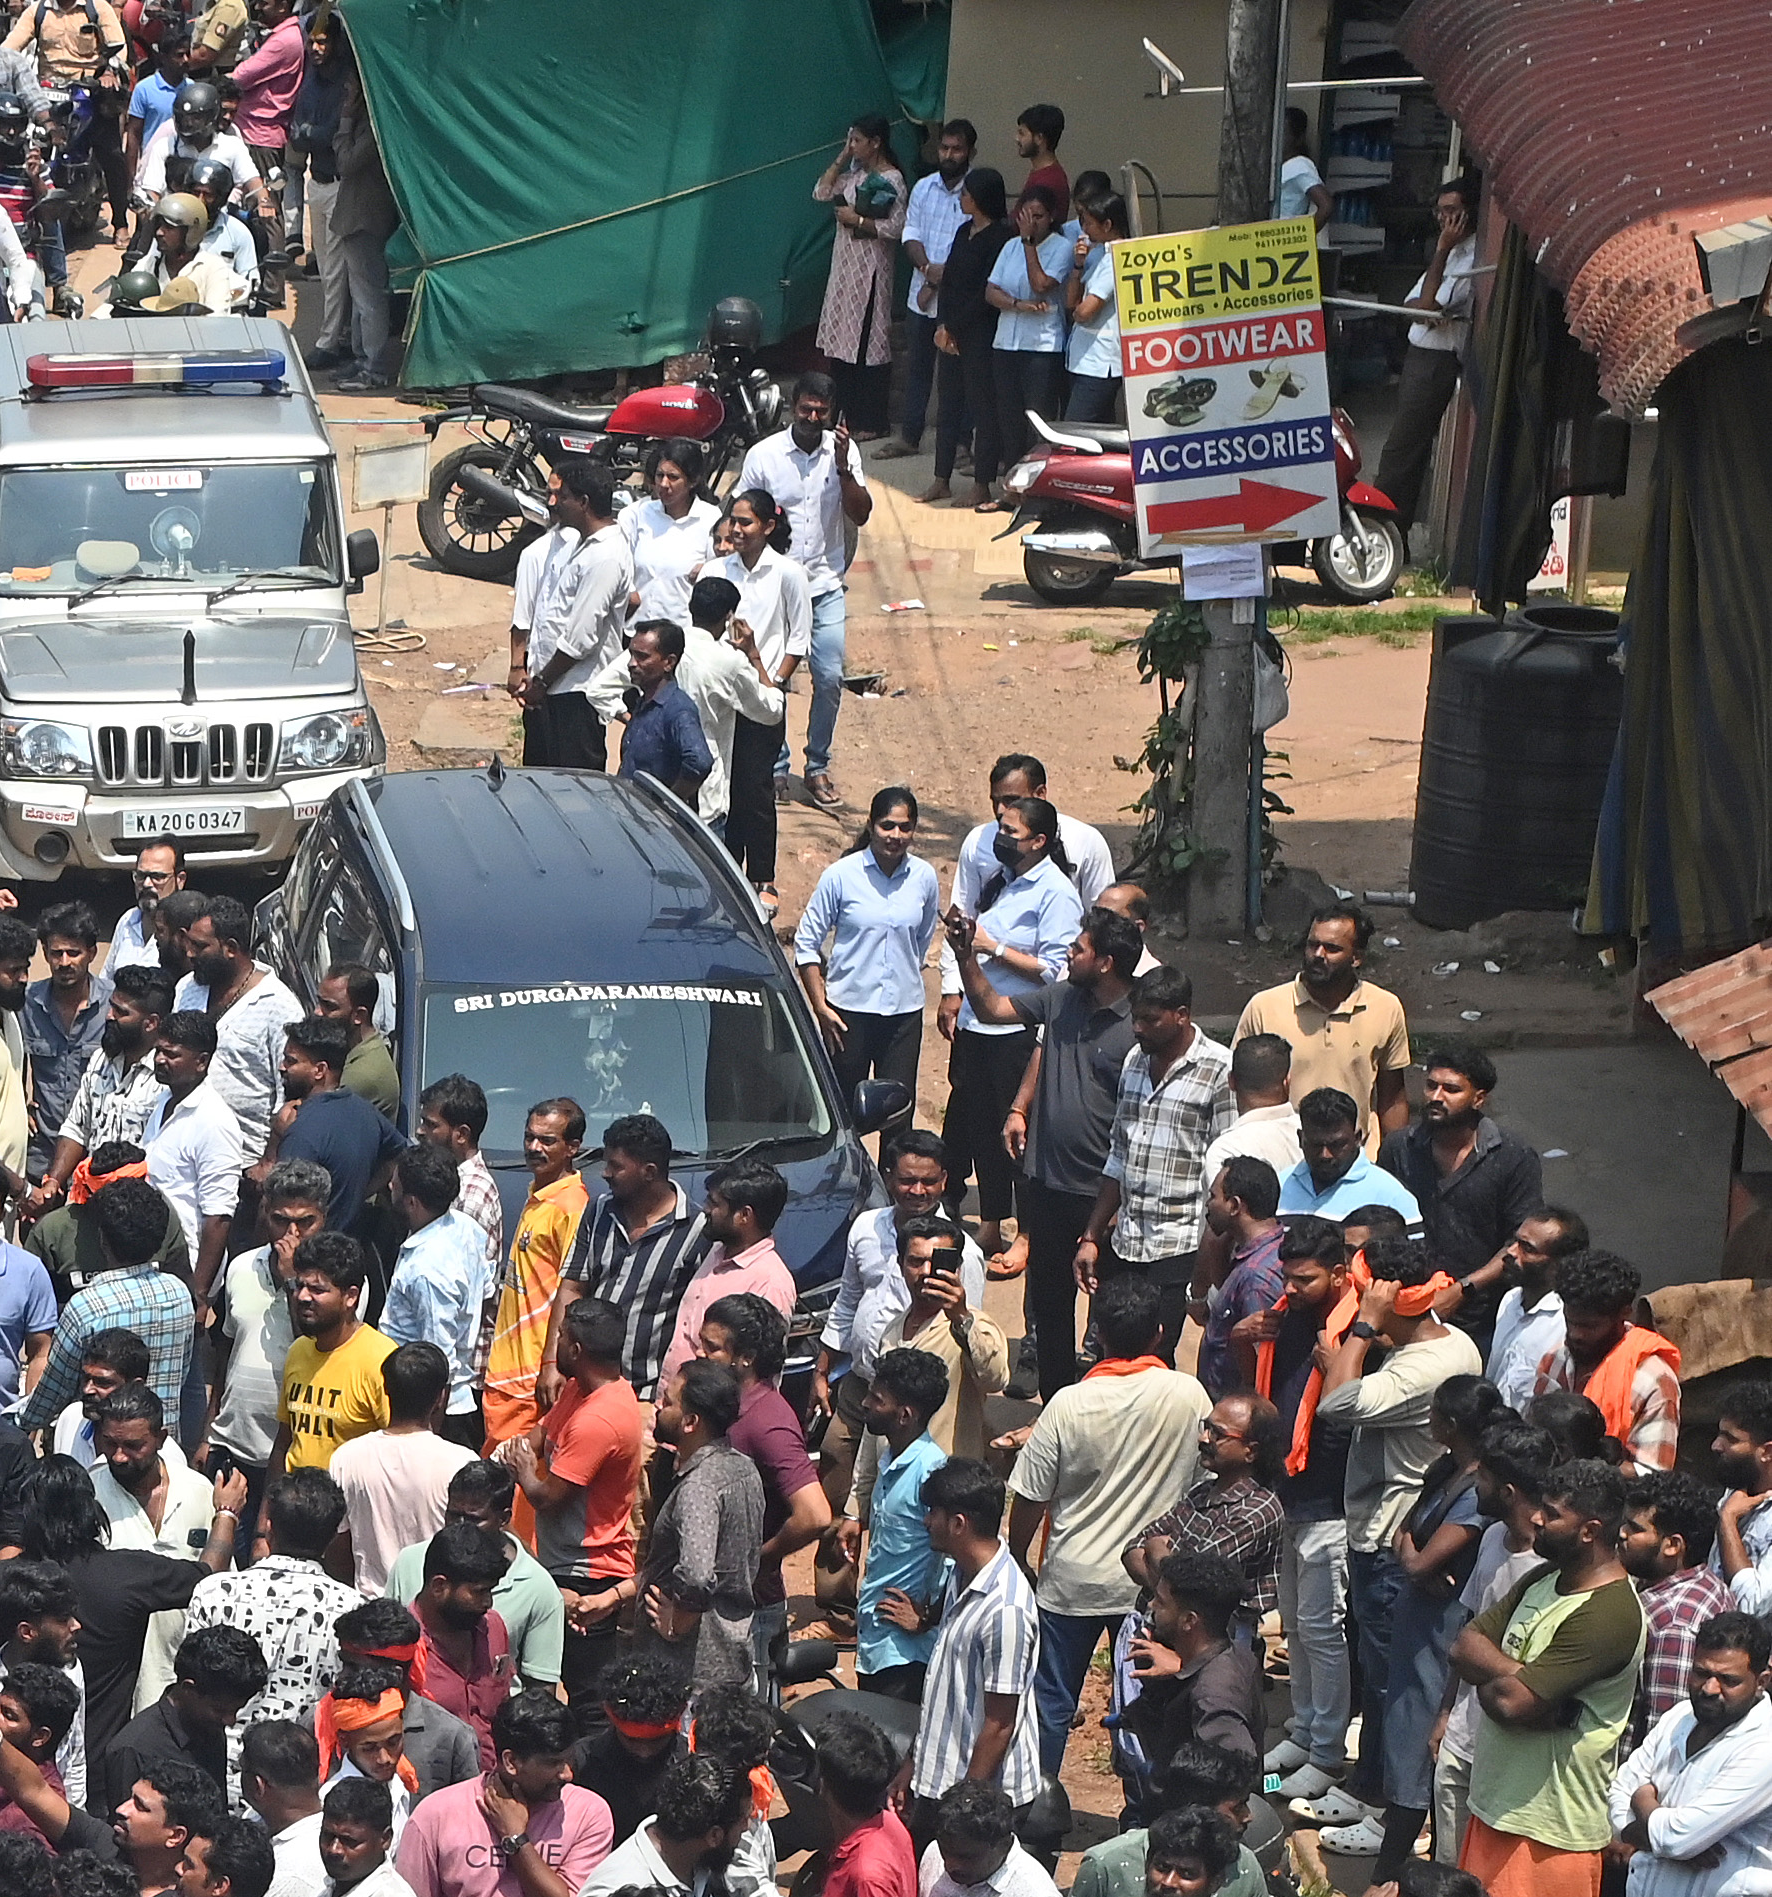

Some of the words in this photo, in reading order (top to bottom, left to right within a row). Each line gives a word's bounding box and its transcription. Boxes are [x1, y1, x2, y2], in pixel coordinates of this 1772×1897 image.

[1122, 245, 1192, 269] Zoya's
[1122, 250, 1312, 304] TRENDZ
[1128, 304, 1204, 323] Footwears
[1223, 288, 1313, 310] Accessories
[1129, 319, 1314, 370] FOOTWEAR
[1140, 426, 1325, 475] ACCESSORIES
[129, 473, 196, 488] POLICE
[454, 994, 492, 1014] SRI
[500, 984, 763, 1008] DURGAPARAMESHWARI
